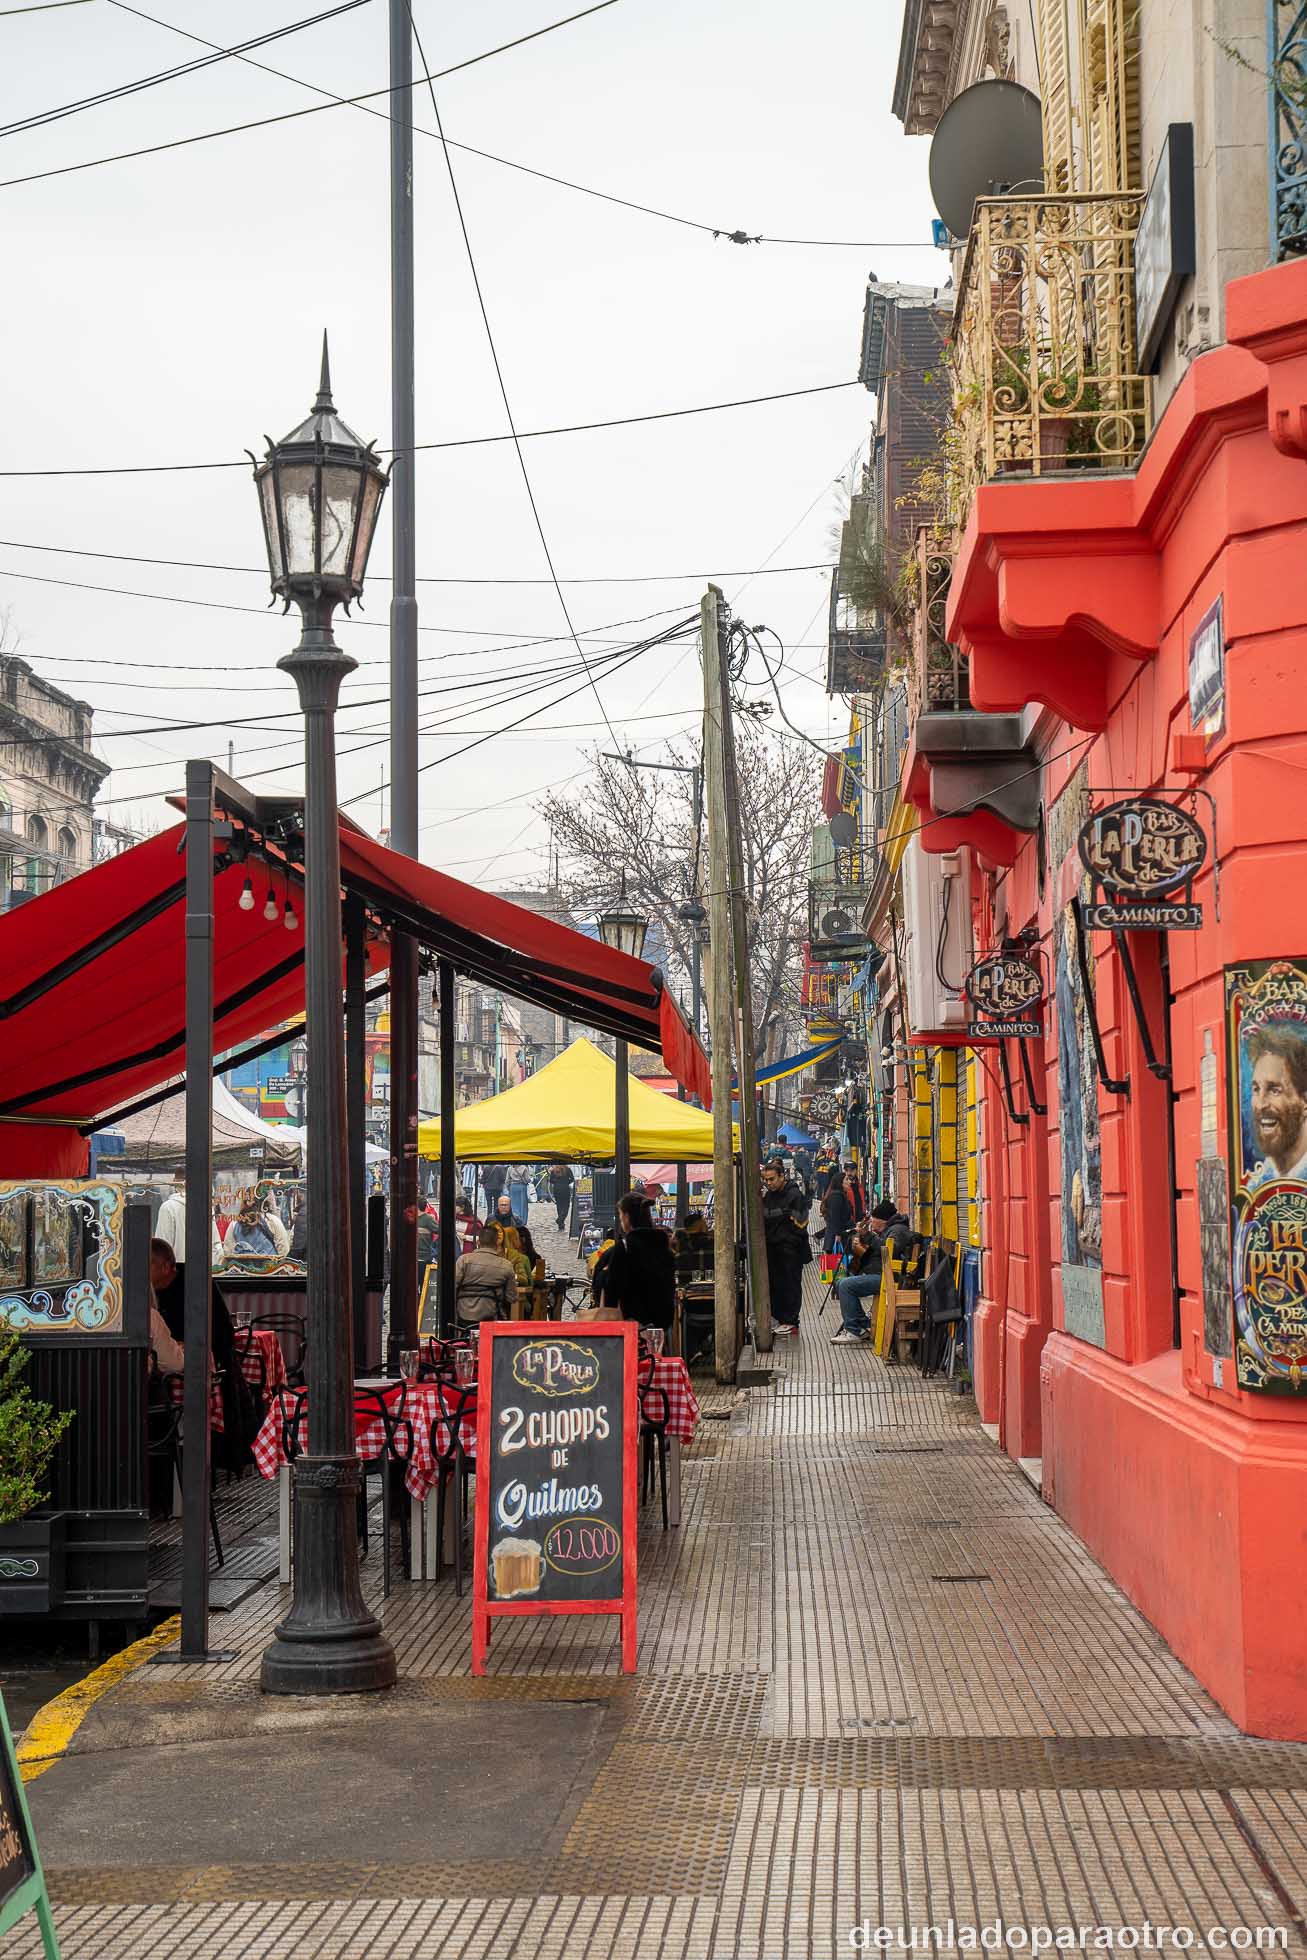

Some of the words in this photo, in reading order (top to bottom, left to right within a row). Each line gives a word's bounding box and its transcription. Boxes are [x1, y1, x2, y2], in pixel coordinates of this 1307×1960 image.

[1148, 813, 1181, 831] BAR
[1091, 817, 1121, 866] LA
[1121, 812, 1198, 874] PERLA
[1138, 861, 1167, 881] de
[1095, 905, 1187, 928] CAMINITO
[1007, 965, 1028, 976] BAR
[991, 966, 1039, 1002] PERLA
[1264, 980, 1307, 1001] BAR
[976, 1022, 1034, 1036] CAMINITO
[524, 1349, 544, 1373] LA
[545, 1346, 594, 1386] PERLA
[499, 1406, 527, 1454] 2
[528, 1405, 610, 1447] CHOPPS
[552, 1448, 569, 1468] DE
[497, 1478, 603, 1529] Quilmes
